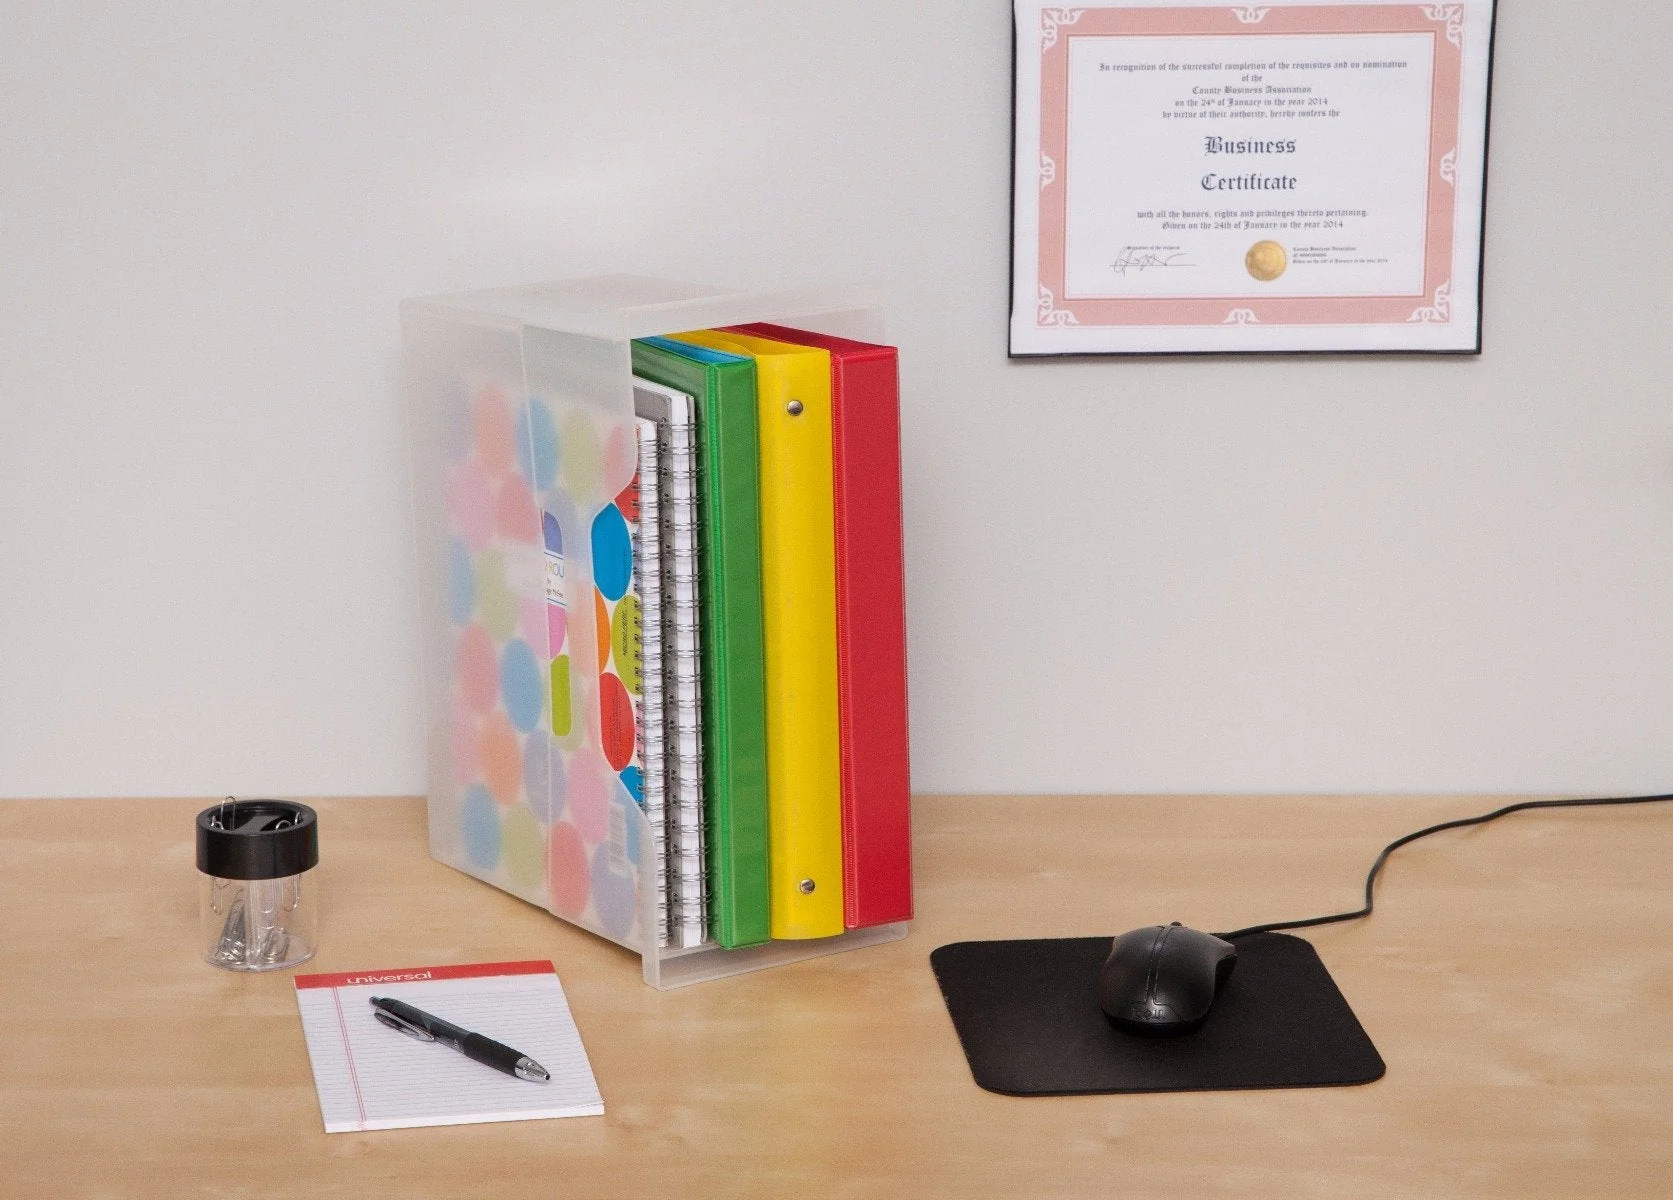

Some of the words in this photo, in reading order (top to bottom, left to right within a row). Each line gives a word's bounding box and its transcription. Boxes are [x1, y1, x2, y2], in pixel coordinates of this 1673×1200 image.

[1100, 63, 1110, 71] In
[1113, 63, 1156, 73] recognition
[1159, 63, 1166, 71] of
[1169, 63, 1179, 71] the
[1182, 63, 1222, 71] successful
[1225, 62, 1266, 70] completion
[1269, 62, 1276, 70] of
[1279, 62, 1290, 70] the
[1293, 62, 1331, 70] requisites
[1334, 61, 1347, 69] and
[1363, 60, 1407, 68] nomination
[1242, 74, 1249, 82] of
[1252, 75, 1262, 83] the
[1192, 86, 1221, 95] County
[1224, 86, 1262, 94] Business
[1266, 86, 1311, 94] Association
[1187, 99, 1198, 107] the
[1218, 99, 1225, 107] of
[1228, 98, 1261, 107] January
[1264, 98, 1272, 106] in
[1275, 98, 1285, 106] the
[1288, 99, 1305, 107] year
[1308, 97, 1328, 106] 2014
[1163, 110, 1172, 119] by
[1174, 111, 1197, 119] virtue
[1199, 111, 1206, 119] of
[1209, 111, 1227, 119] their
[1270, 110, 1295, 118] hereby
[1298, 110, 1326, 118] confers
[1329, 109, 1340, 117] the
[1204, 136, 1296, 155] Business
[1201, 173, 1298, 191] Certificate
[1137, 210, 1154, 219] with
[1156, 211, 1166, 219] all
[1169, 211, 1179, 219] the
[1214, 209, 1238, 219] rights
[1240, 209, 1254, 218] and
[1257, 209, 1296, 219] privileges
[1297, 208, 1323, 217] thereto
[1162, 222, 1185, 230] Given
[1188, 222, 1198, 230] on
[1201, 222, 1211, 230] the
[1214, 221, 1232, 230] 24th
[1234, 221, 1241, 229] of
[1244, 221, 1277, 230] January
[1280, 221, 1288, 229] in
[1291, 221, 1301, 229] the
[1304, 221, 1320, 230] year
[1323, 219, 1344, 229] 2014
[346, 970, 432, 984] universal
